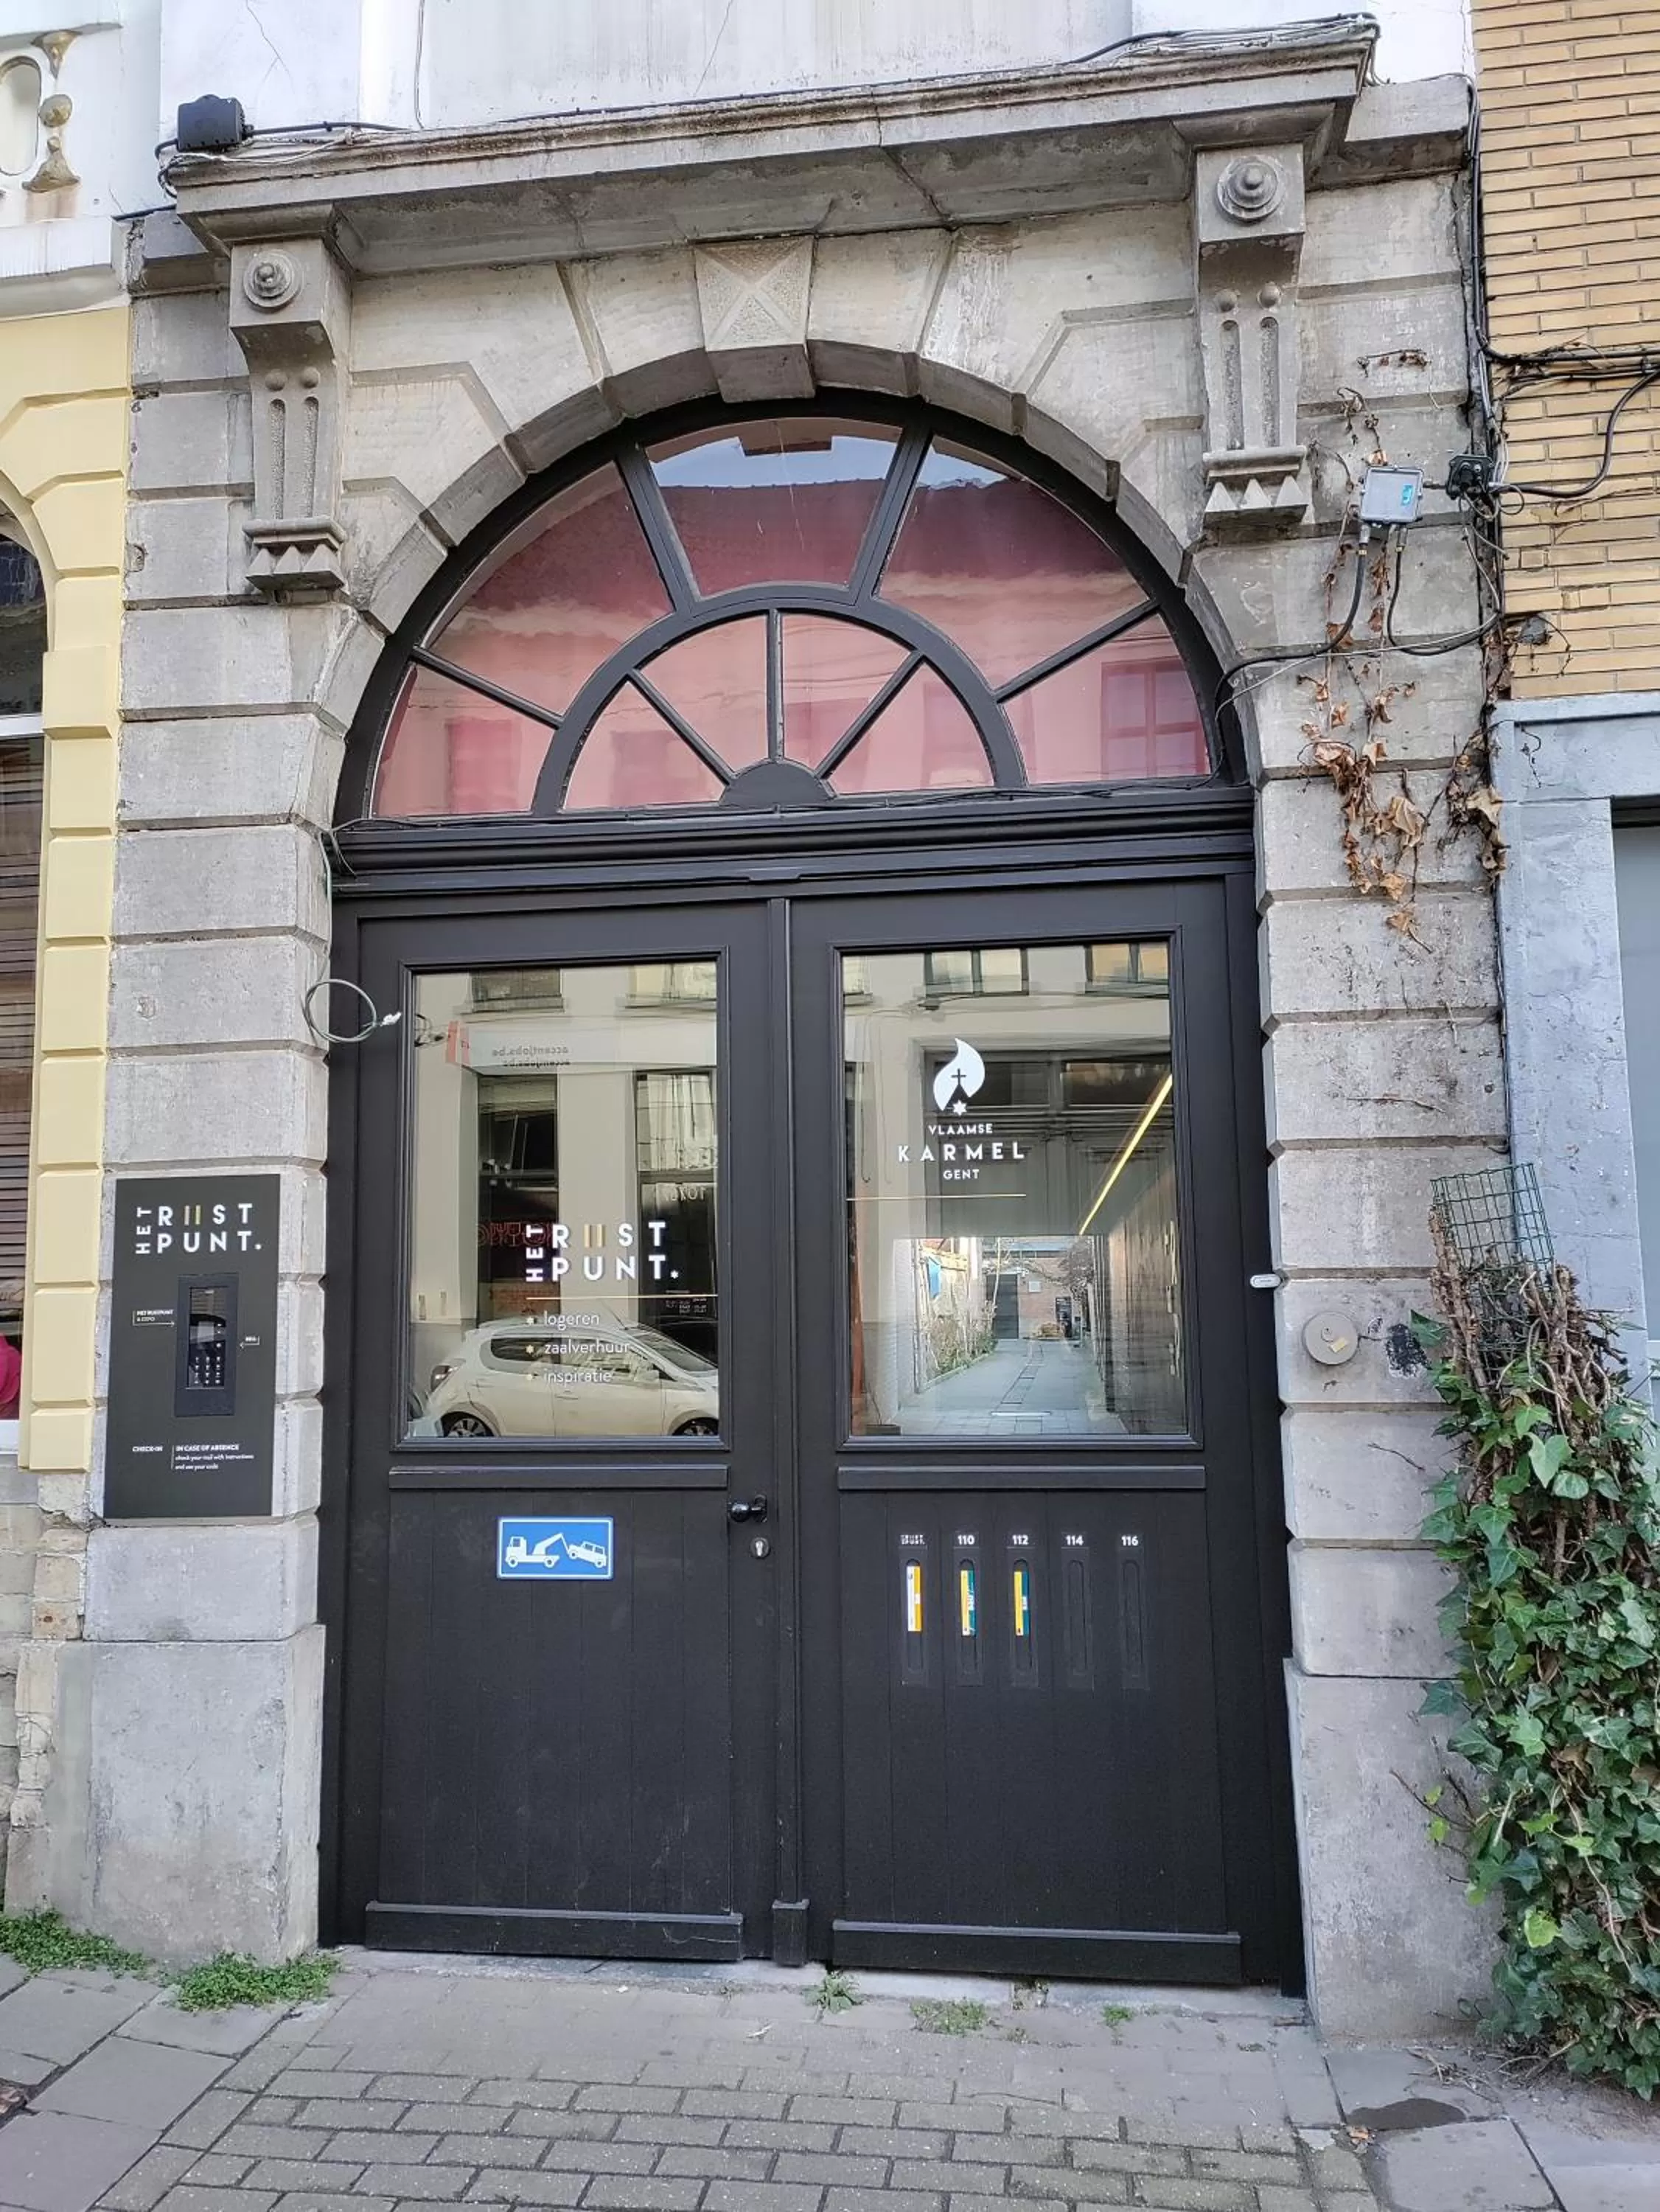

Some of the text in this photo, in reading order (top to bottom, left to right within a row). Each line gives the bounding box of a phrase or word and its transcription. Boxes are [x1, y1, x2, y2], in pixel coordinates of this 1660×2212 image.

[928, 1123, 993, 1135] VLAAMSE
[898, 1141, 1025, 1162] KARMEL
[943, 1169, 980, 1180] GENT
[544, 1310, 600, 1331] logeren
[544, 1339, 630, 1354] zaalverhuur
[544, 1368, 613, 1387] inspiratie
[958, 1534, 975, 1545] 110
[1012, 1534, 1029, 1545] 112
[1065, 1535, 1084, 1546] 114
[1121, 1535, 1139, 1547] 116
